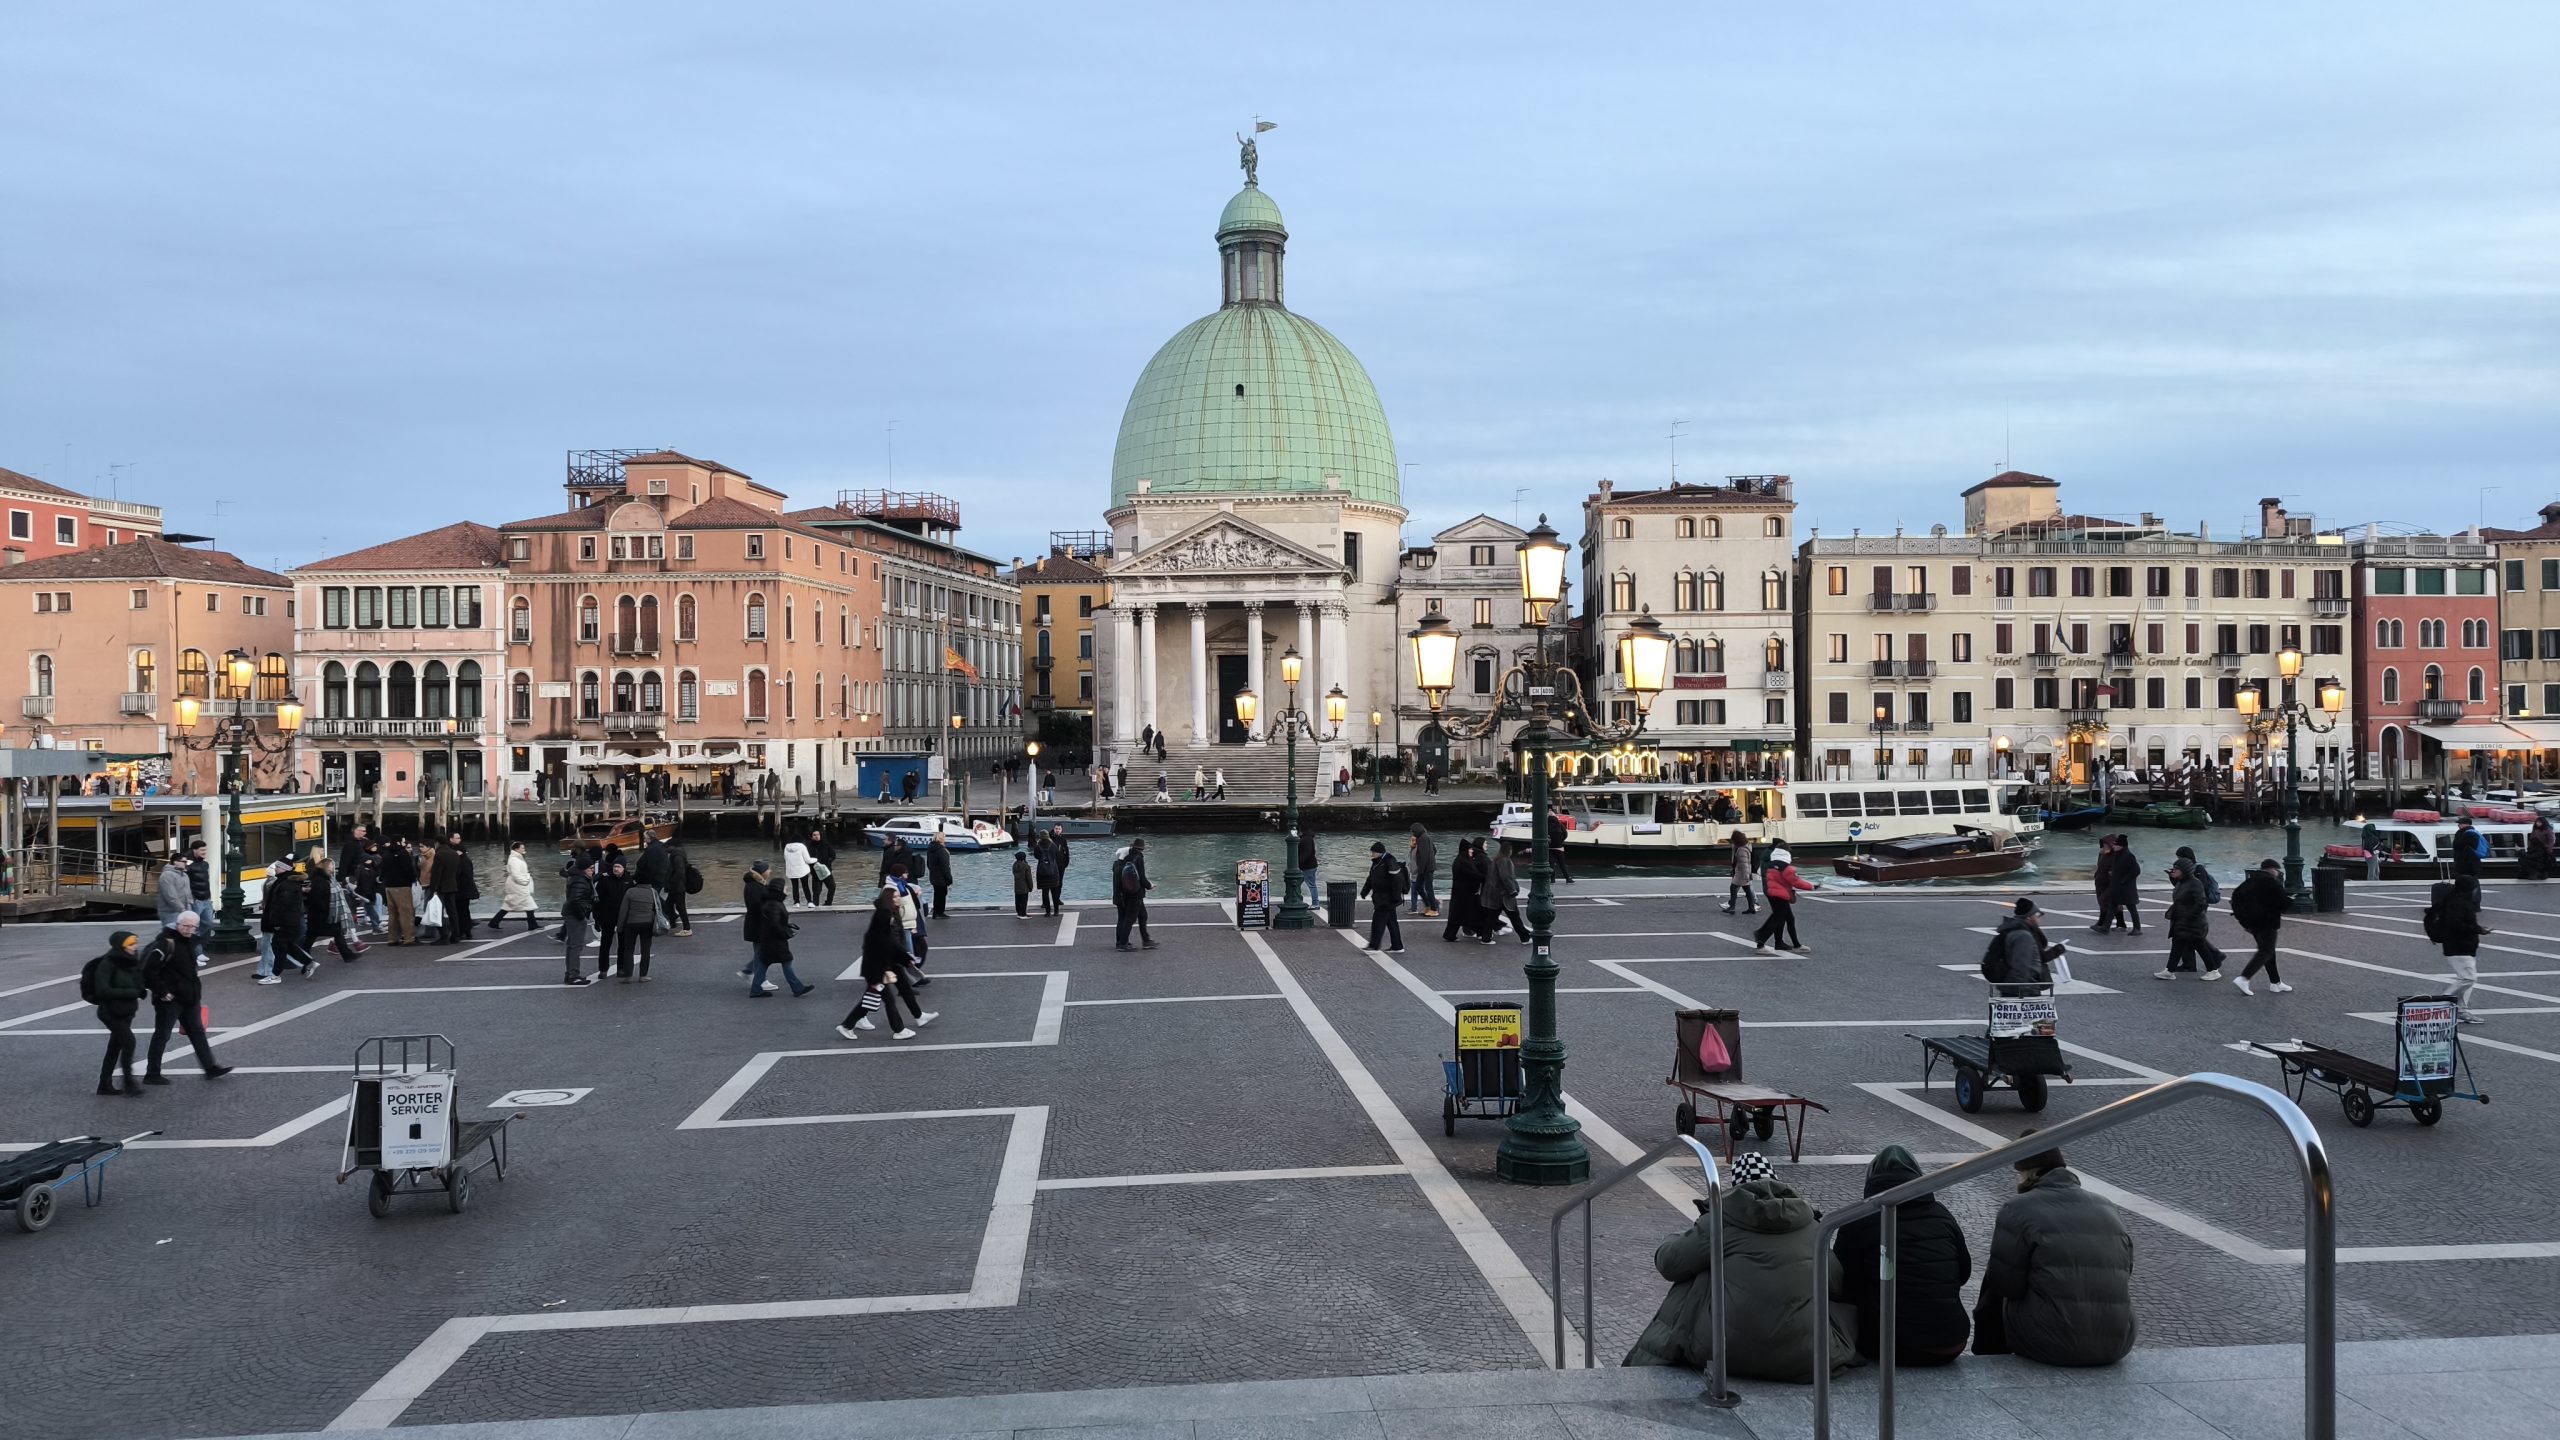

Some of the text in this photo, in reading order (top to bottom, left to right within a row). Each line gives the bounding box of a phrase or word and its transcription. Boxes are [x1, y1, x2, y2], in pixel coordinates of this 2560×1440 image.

[1993, 656, 2021, 667] Hotel
[2058, 657, 2097, 667] Carlton
[2147, 656, 2180, 667] Grand
[2184, 656, 2212, 667] Canal
[312, 822, 320, 834] B
[1864, 822, 1880, 830] Actv
[1463, 1014, 1517, 1024] PORTER SERVICE
[2023, 1011, 2057, 1019] SERVICE
[2406, 1023, 2428, 1044] PORTER
[387, 1092, 443, 1105] PORTER
[391, 1104, 439, 1116] SERVICE
